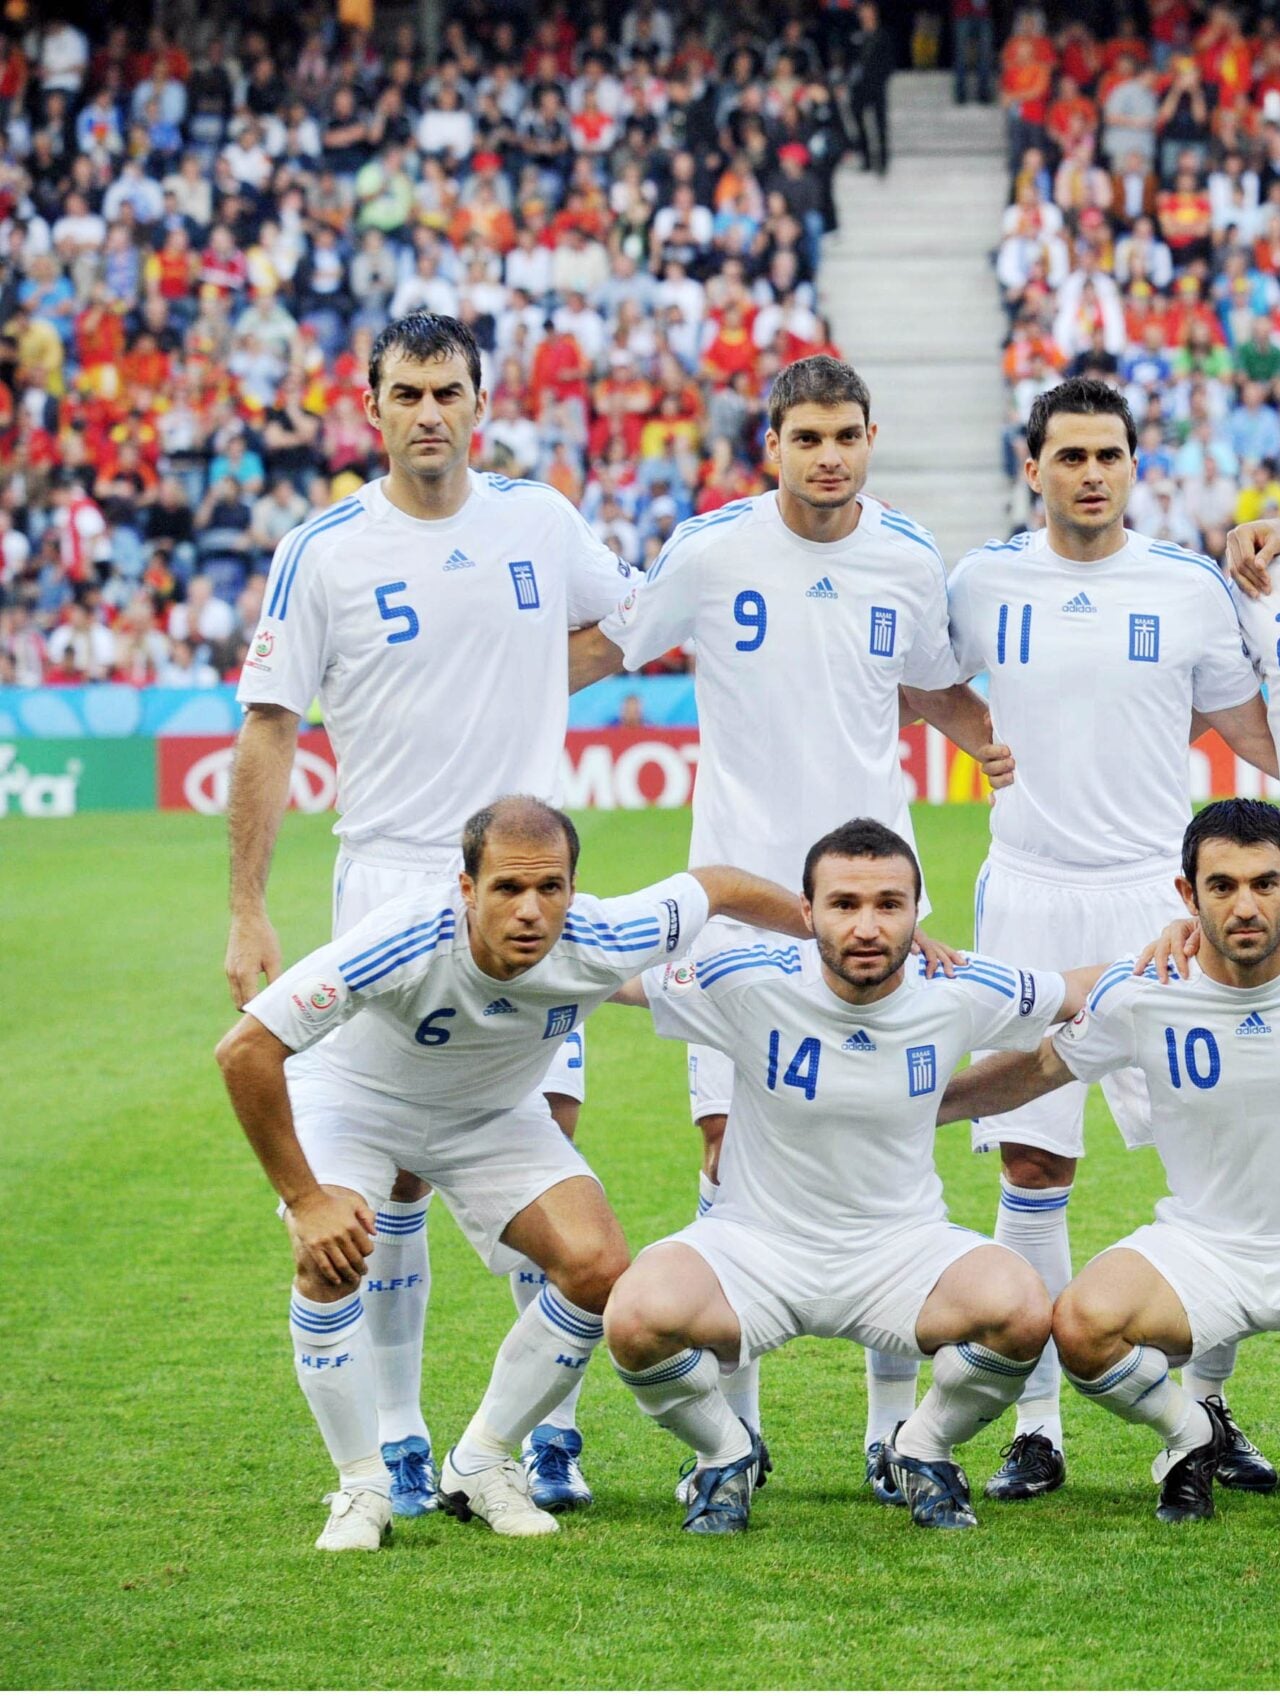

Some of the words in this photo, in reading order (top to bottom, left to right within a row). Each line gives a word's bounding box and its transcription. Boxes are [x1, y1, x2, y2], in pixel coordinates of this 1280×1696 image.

[805, 588, 839, 600] adidas
[374, 581, 420, 645] 5
[733, 589, 768, 652] 9
[1062, 604, 1097, 614] adidas
[997, 604, 1033, 665] 11
[483, 1006, 518, 1017] adidas
[415, 1008, 457, 1046] 6
[1235, 1024, 1272, 1035] adidas
[841, 1041, 877, 1052] adidas
[1164, 1026, 1221, 1089] 10
[767, 1029, 822, 1100] 14
[367, 1274, 422, 1292] H.F.F.
